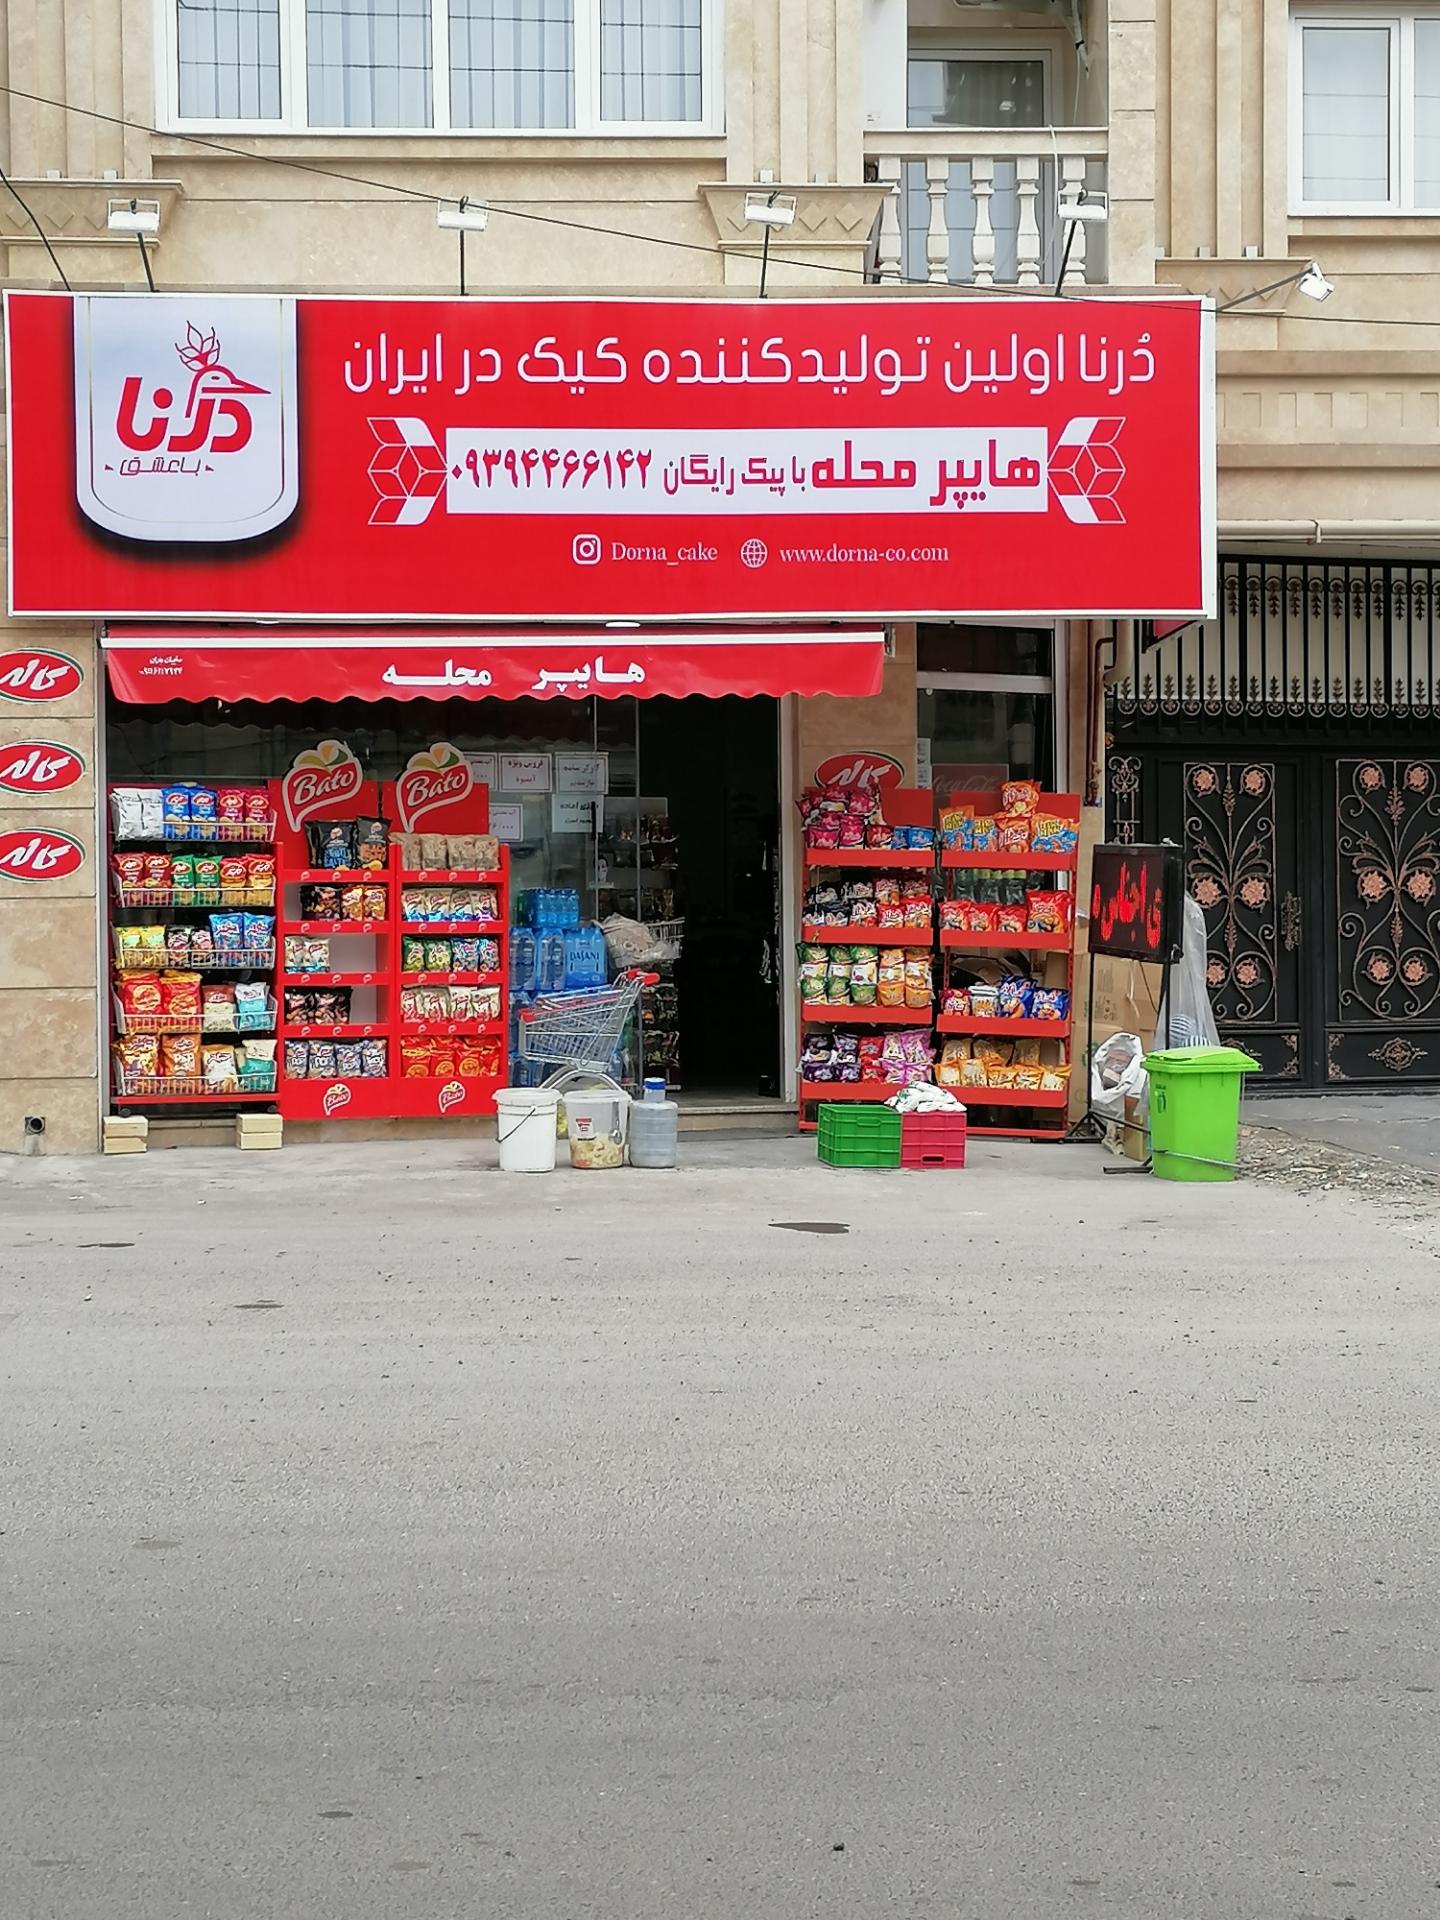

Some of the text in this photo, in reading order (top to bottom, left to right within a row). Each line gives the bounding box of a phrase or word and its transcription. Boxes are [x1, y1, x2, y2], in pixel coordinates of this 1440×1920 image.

[344, 333, 443, 395] ایران
[454, 348, 502, 395] در
[517, 336, 627, 394] کیک
[944, 333, 1064, 395] اولین
[116, 376, 252, 453] درنا
[451, 439, 1041, 510] هایپر محله با پیک رایگان ۰۹۳۹۴۴۶۶۱۴۲
[612, 542, 718, 566] Dorna_cake
[780, 543, 949, 562] www.dorna-co.com
[382, 656, 646, 693] هایپر محله
[293, 768, 355, 803] Bato
[406, 771, 466, 804] Bato
